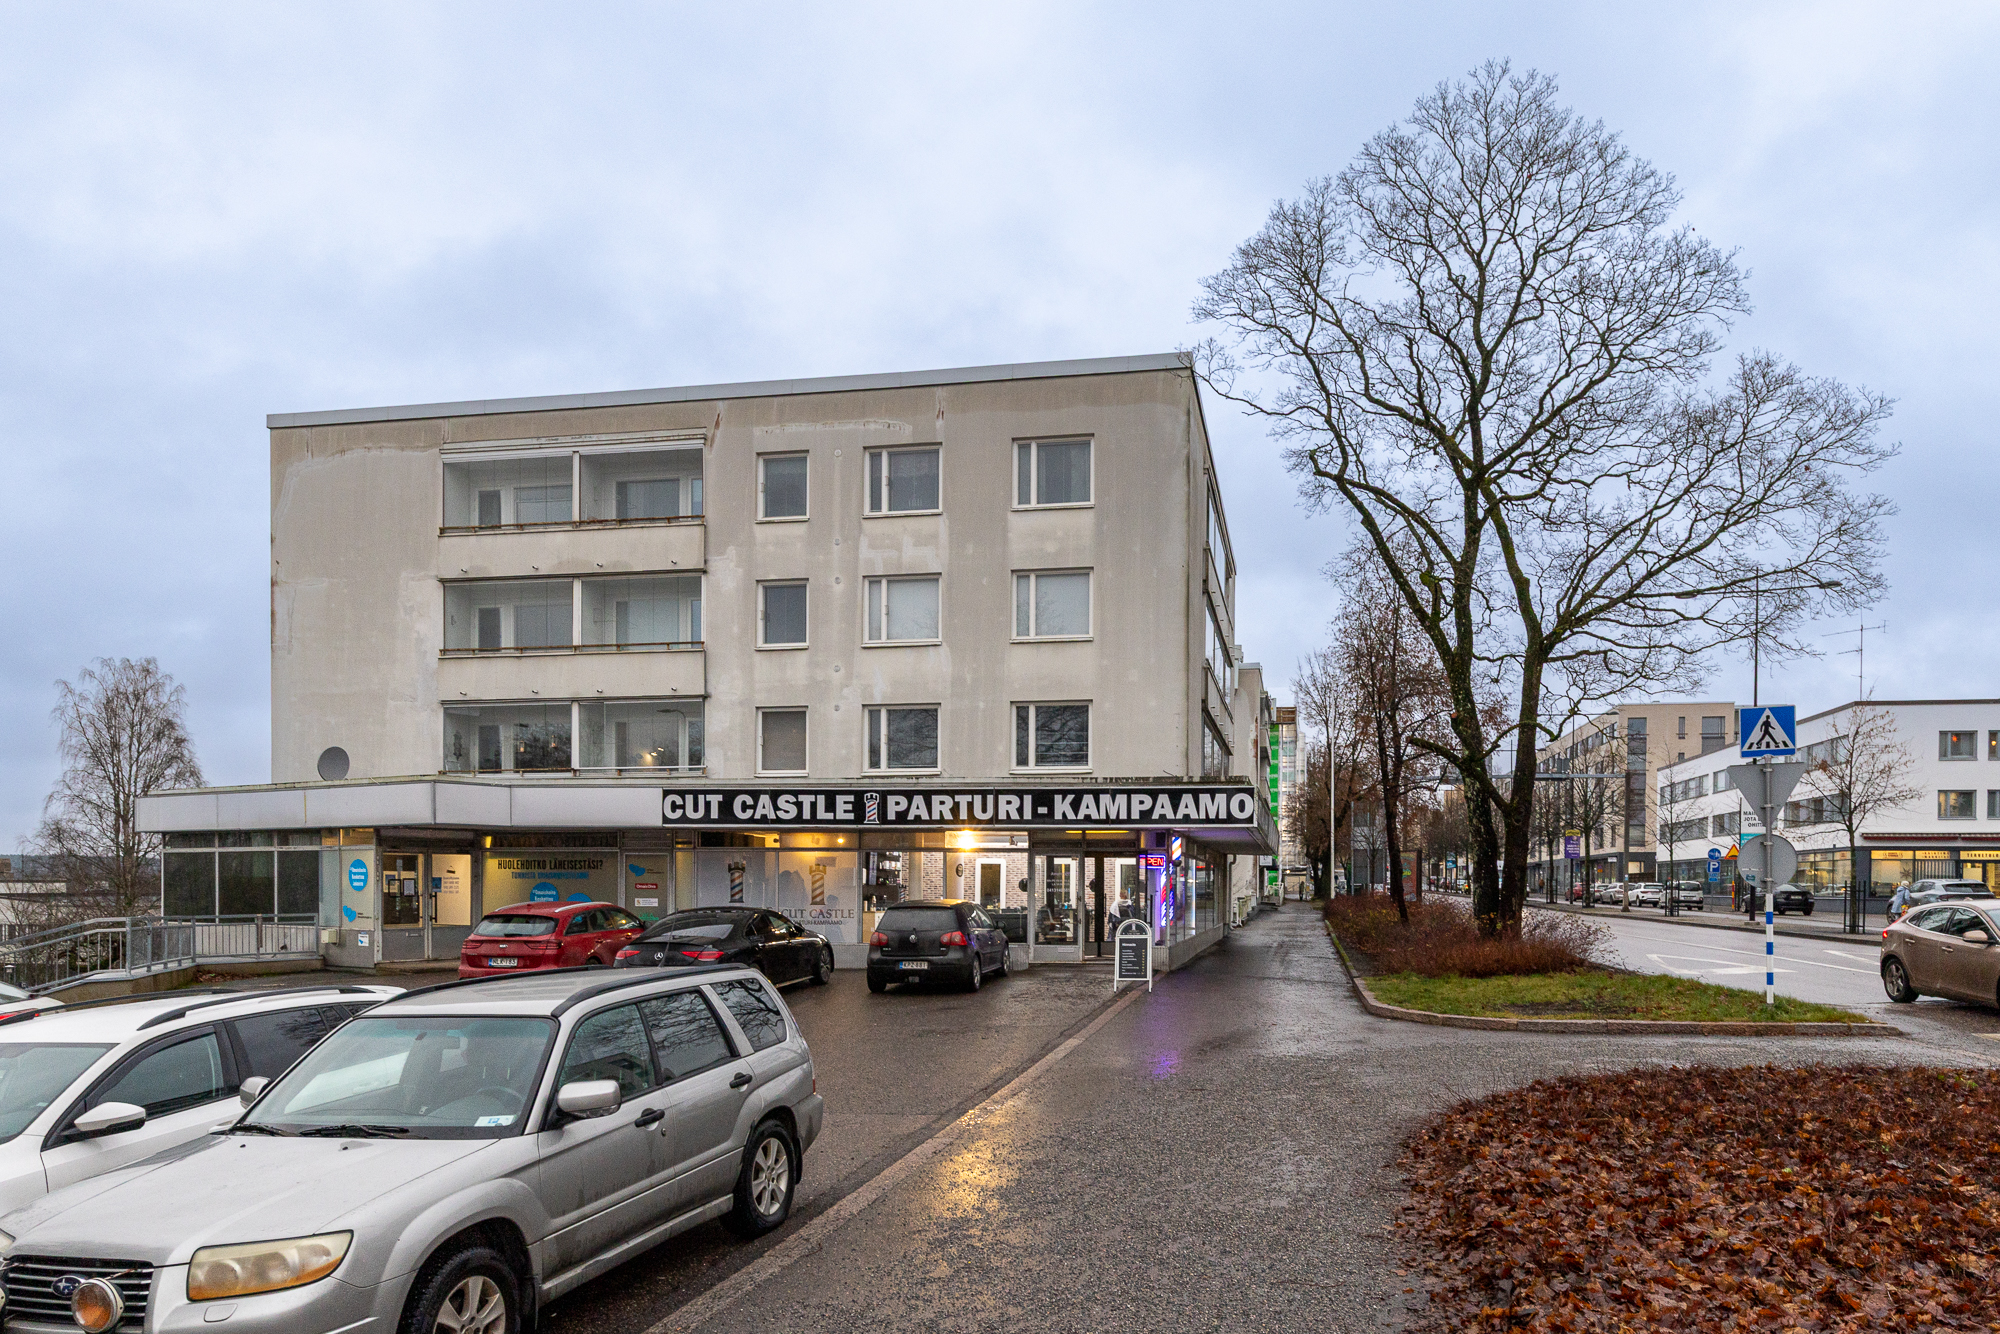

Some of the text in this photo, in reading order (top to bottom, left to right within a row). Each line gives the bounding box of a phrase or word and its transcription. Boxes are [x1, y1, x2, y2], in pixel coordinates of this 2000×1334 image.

[663, 794, 723, 820] CUT
[732, 794, 855, 820] CASTLE
[497, 857, 604, 870] HUOLEHDITKO LÄHEISESTÄSI?
[1710, 862, 1719, 872] P
[781, 908, 855, 919] CUT CASTLE
